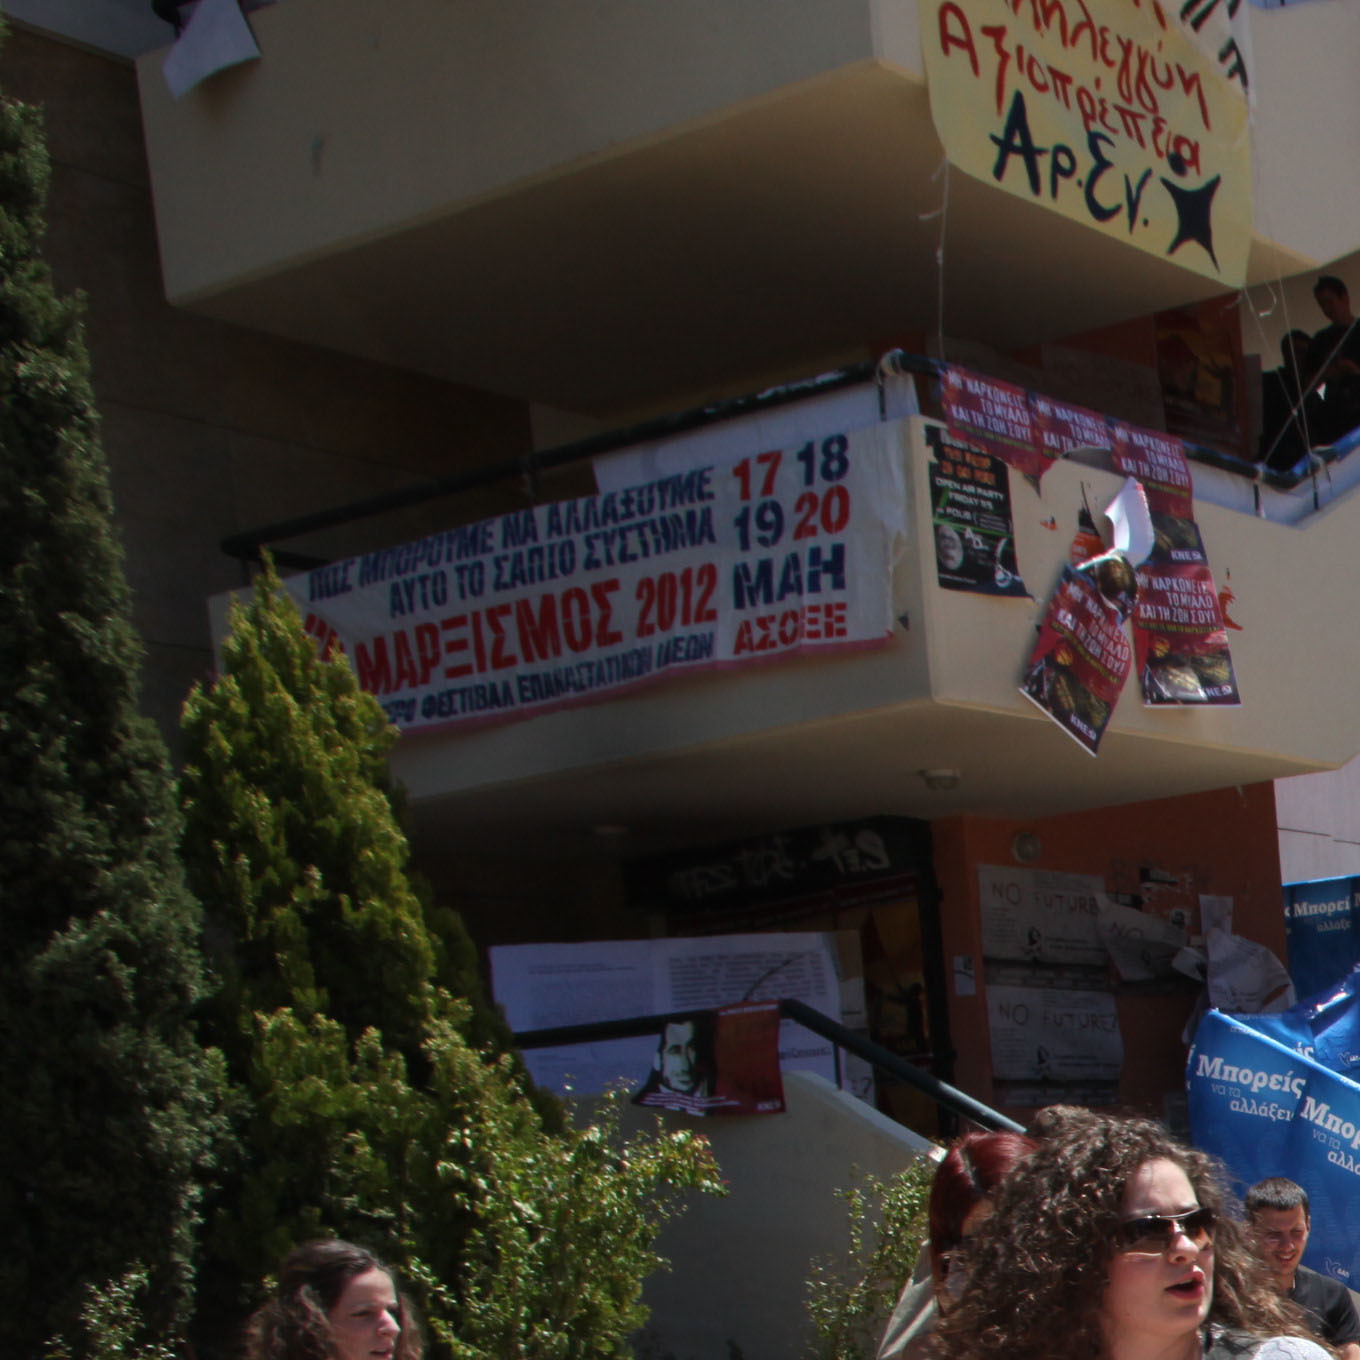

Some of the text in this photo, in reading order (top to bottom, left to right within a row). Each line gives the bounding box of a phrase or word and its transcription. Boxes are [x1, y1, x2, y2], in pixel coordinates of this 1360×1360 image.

[502, 508, 540, 549] ΝΑ
[546, 466, 716, 538] ΑΛΛΑΞΟΥΜΕ
[733, 450, 783, 500] 17
[796, 434, 850, 487] 18
[389, 484, 851, 620] ΑΥΤΟ ΤΟ ΣΑΠΙΟ ΣΥΣΤΗΜΑ 19 20
[354, 577, 625, 697] ΜΑΡΞΙΣΜΟΣ
[635, 563, 719, 638] 2012
[732, 542, 847, 611] ΜΑΗ
[991, 881, 1023, 906] NO
[1293, 896, 1351, 919] Μπορεί
[999, 1003, 1030, 1026] NO
[1196, 1054, 1306, 1100] Μπορείς
[1230, 1098, 1295, 1123] αλλάξει
